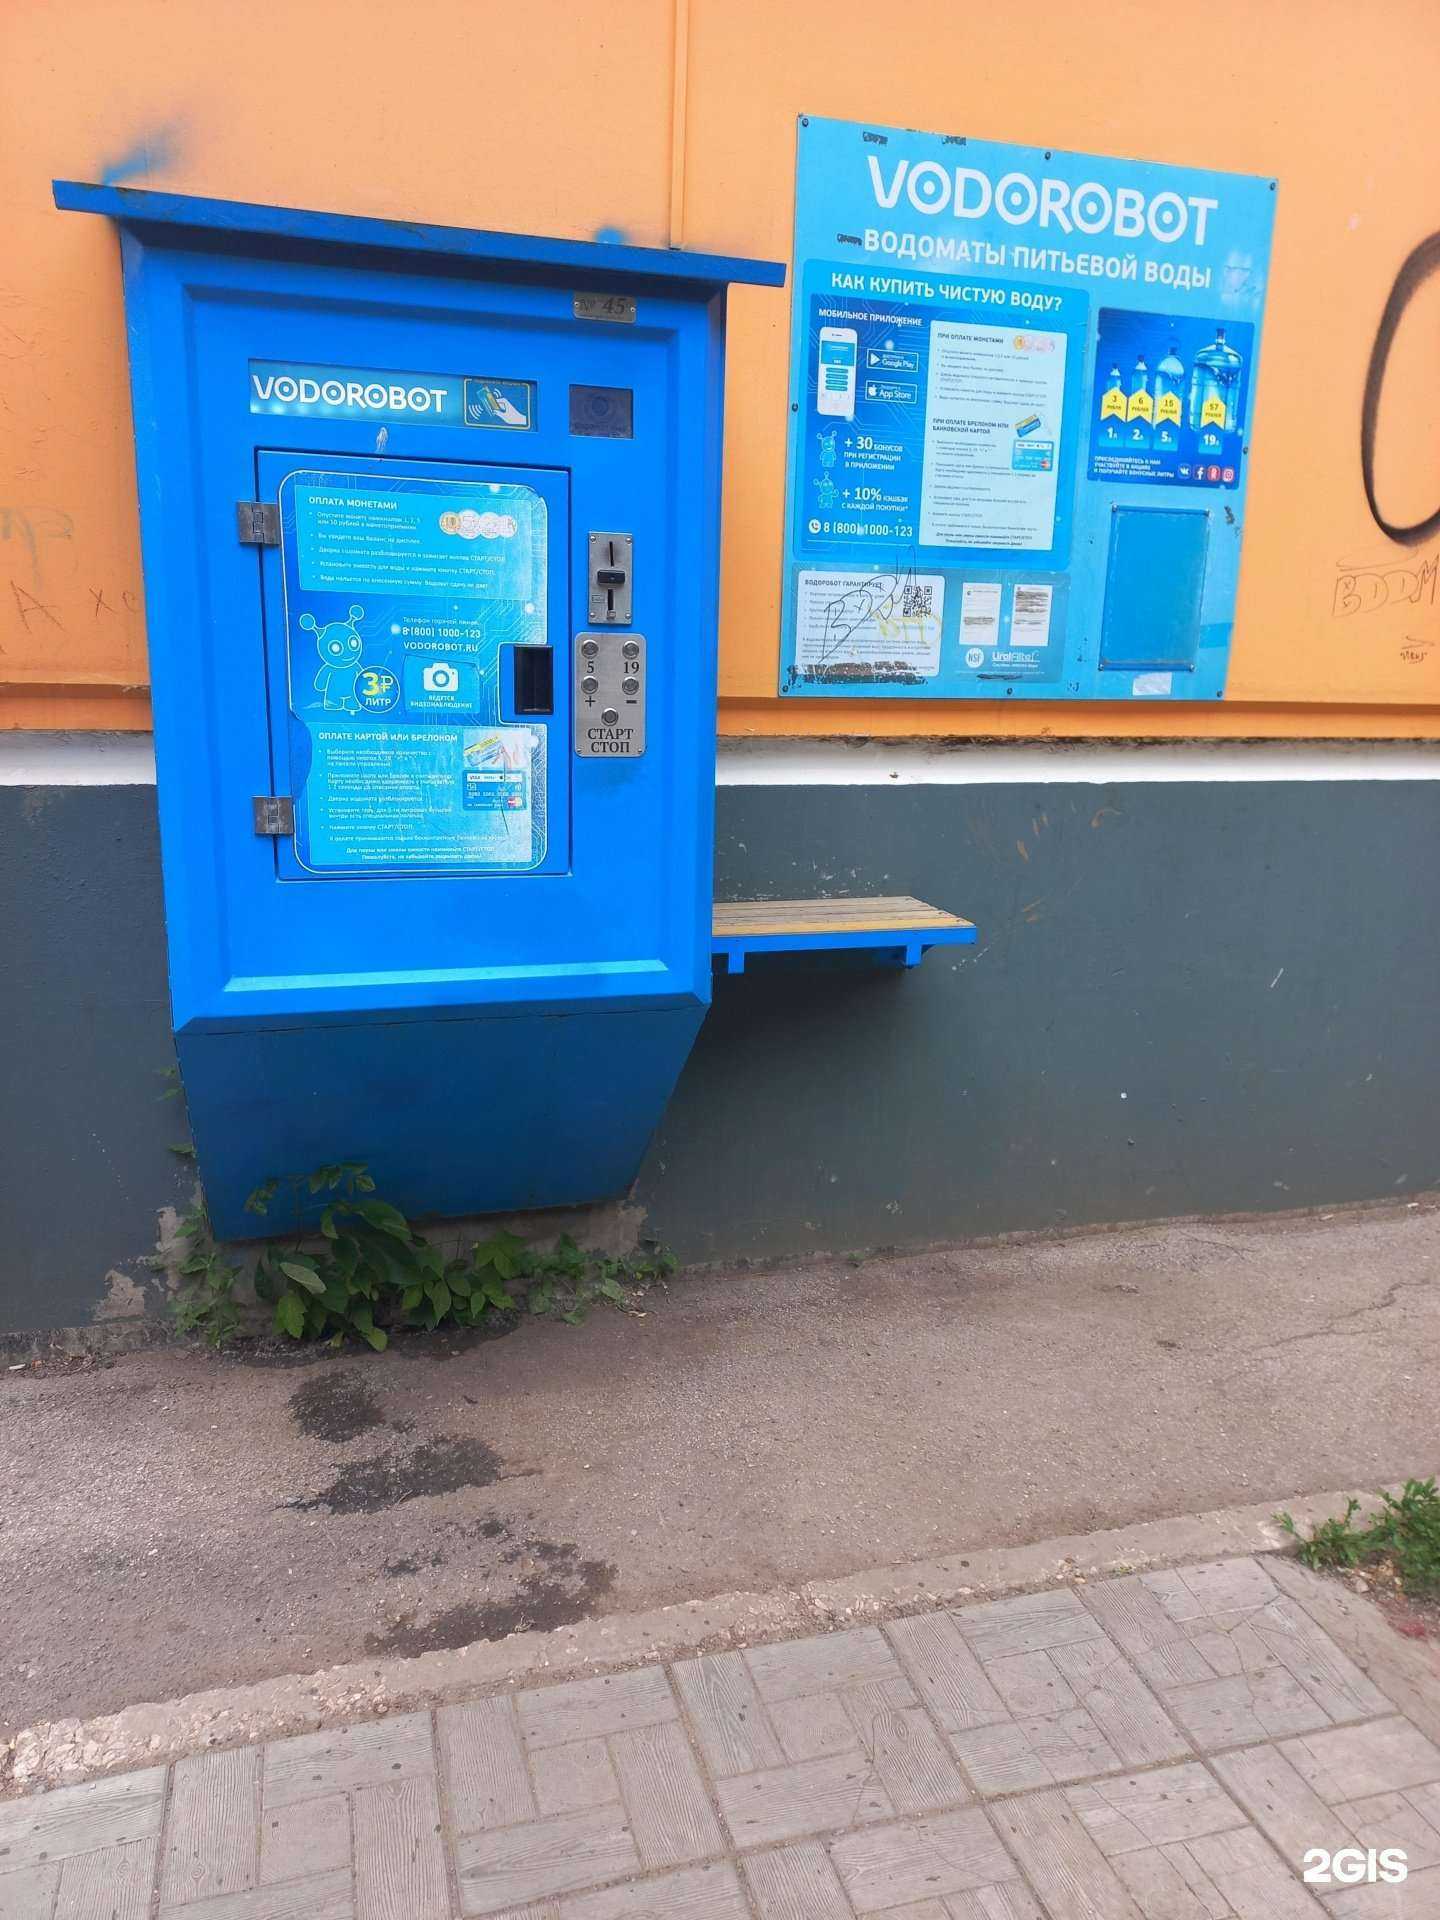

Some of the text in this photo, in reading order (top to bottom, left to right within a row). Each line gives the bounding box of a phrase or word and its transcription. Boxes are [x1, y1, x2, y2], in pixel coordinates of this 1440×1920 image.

[867, 155, 1219, 246] VODOROBOT
[864, 228, 1212, 290] ВОДОМАТЫ ПИТЬЕВОЙ ВОДЫ
[831, 272, 1063, 312] КАК КУПИТЬ ЧИСТУЮ ВОДУ?
[818, 308, 922, 327] МОБИЛЬНОЕ ПРИЛОЖЕНИЕ
[252, 375, 448, 413] VODOROBOT
[856, 436, 873, 450] 30
[844, 451, 858, 459] ПРИ
[854, 487, 882, 502] 10%
[309, 496, 398, 510] ОПЛАТА МОНЕТАМИ
[823, 522, 913, 537] 8 (800) 1000-123
[805, 579, 841, 587] ВОДОРОБОТ
[438, 628, 481, 639] 1000-123
[403, 642, 478, 653] VODOROBOT.RU
[587, 661, 594, 673] 5
[623, 661, 640, 673] 19
[365, 697, 392, 707] ЛИТР
[319, 731, 458, 742] ОПЛАТЕ КАРТОЙ ИЛИ БРЕЛОКОМ
[588, 729, 634, 740] СТАРТ
[591, 742, 630, 753] СТОП
